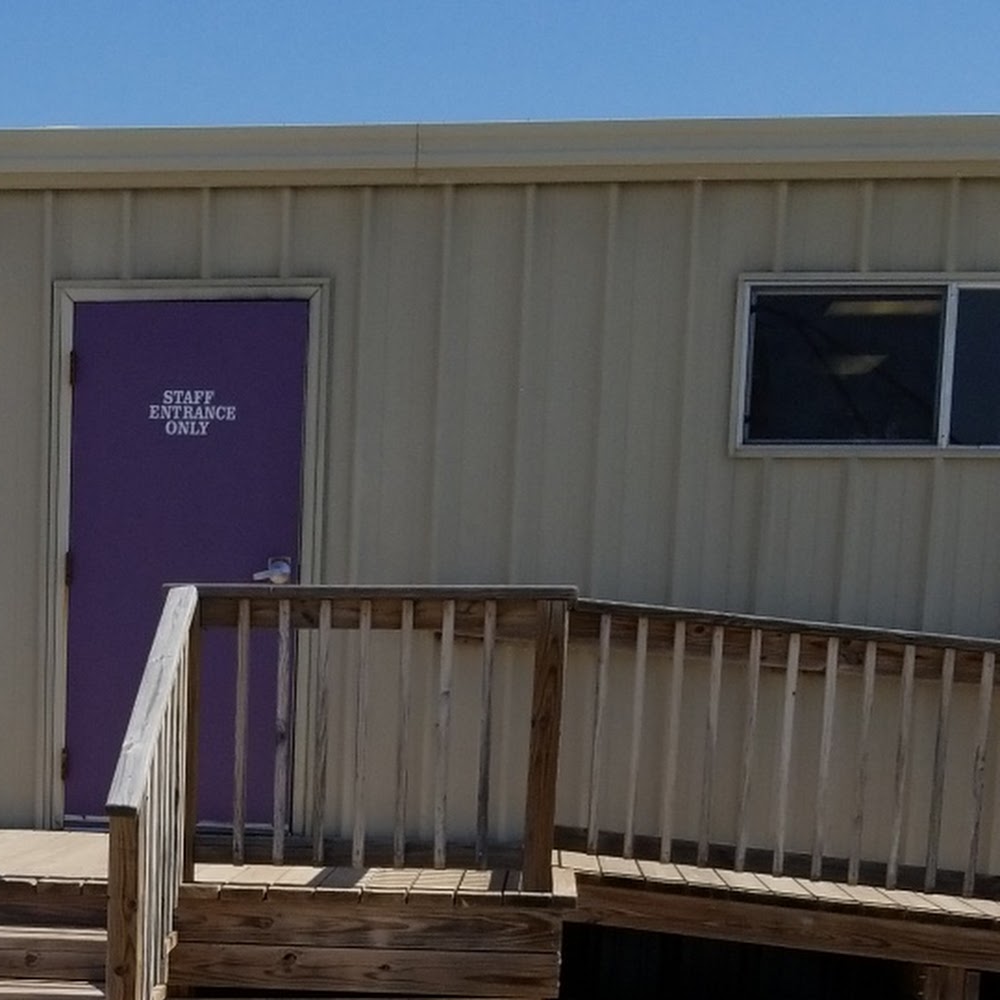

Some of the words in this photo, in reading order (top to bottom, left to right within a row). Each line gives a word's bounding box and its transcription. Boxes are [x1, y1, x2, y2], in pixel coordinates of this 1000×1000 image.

[162, 390, 215, 404] STAFF
[148, 405, 236, 420] ENTRANCE
[165, 420, 210, 435] ONLY
